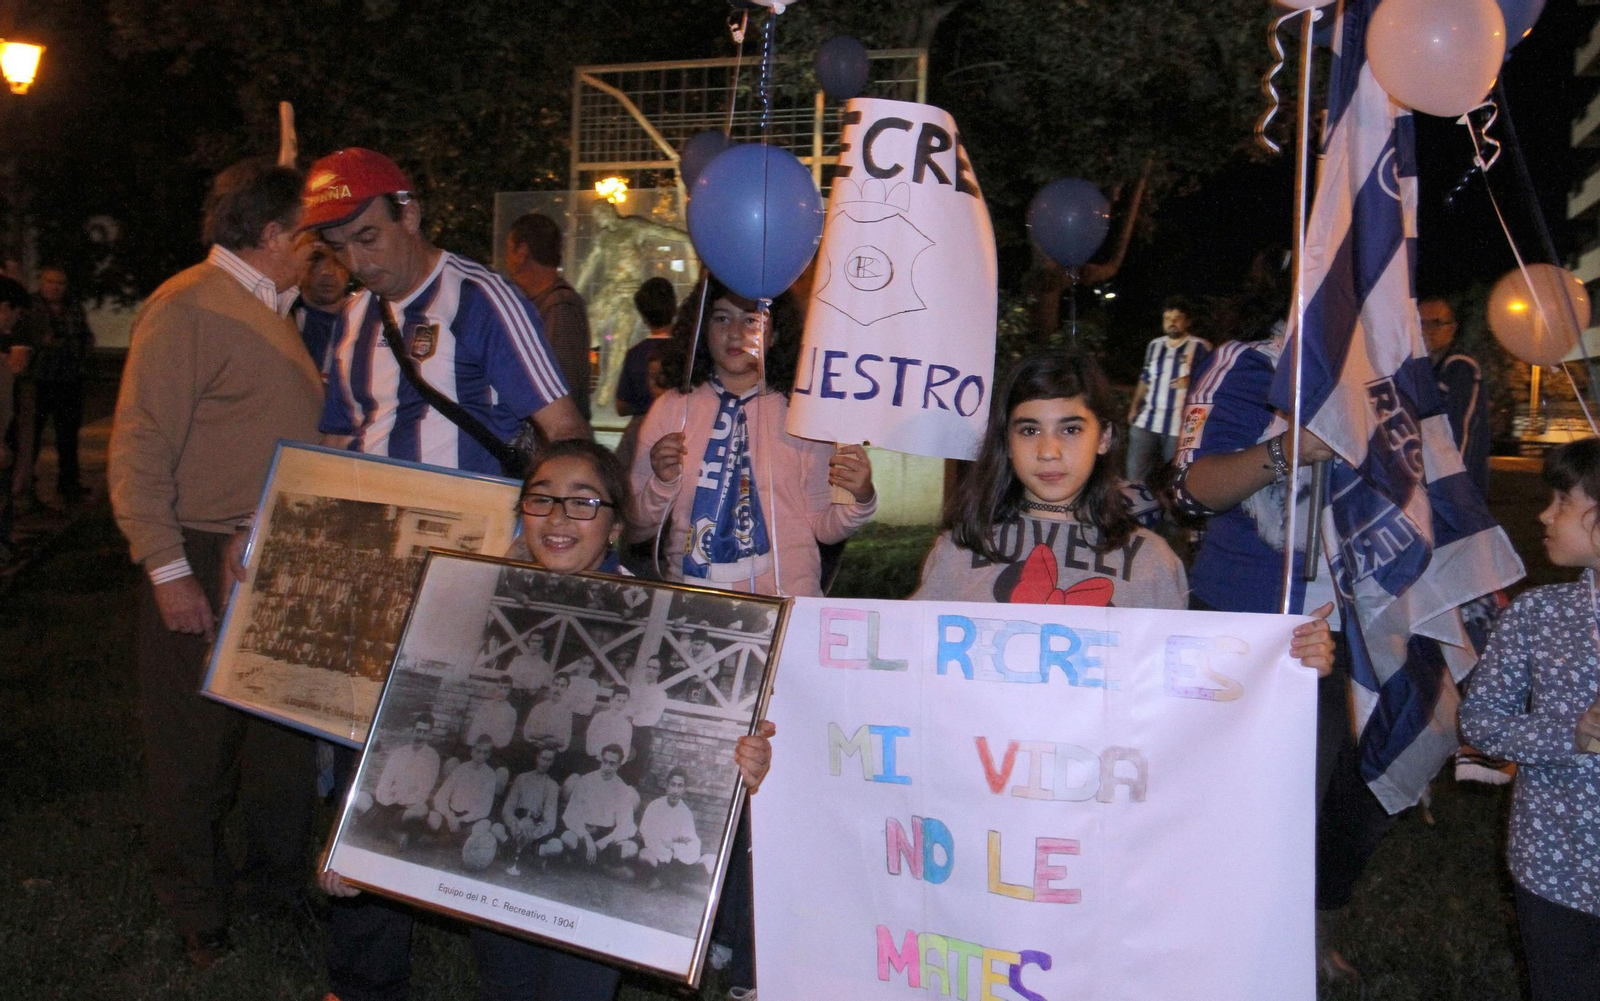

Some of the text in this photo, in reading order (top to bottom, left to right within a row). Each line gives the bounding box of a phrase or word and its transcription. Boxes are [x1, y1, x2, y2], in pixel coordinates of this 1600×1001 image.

[819, 607, 1250, 701] EL RECRE ES
[828, 721, 1148, 803] MI VIDA
[987, 829, 1082, 904] LE
[438, 883, 575, 930] Equipo del R. C. Recreativo, 1904
[876, 924, 1052, 1001] MATES
